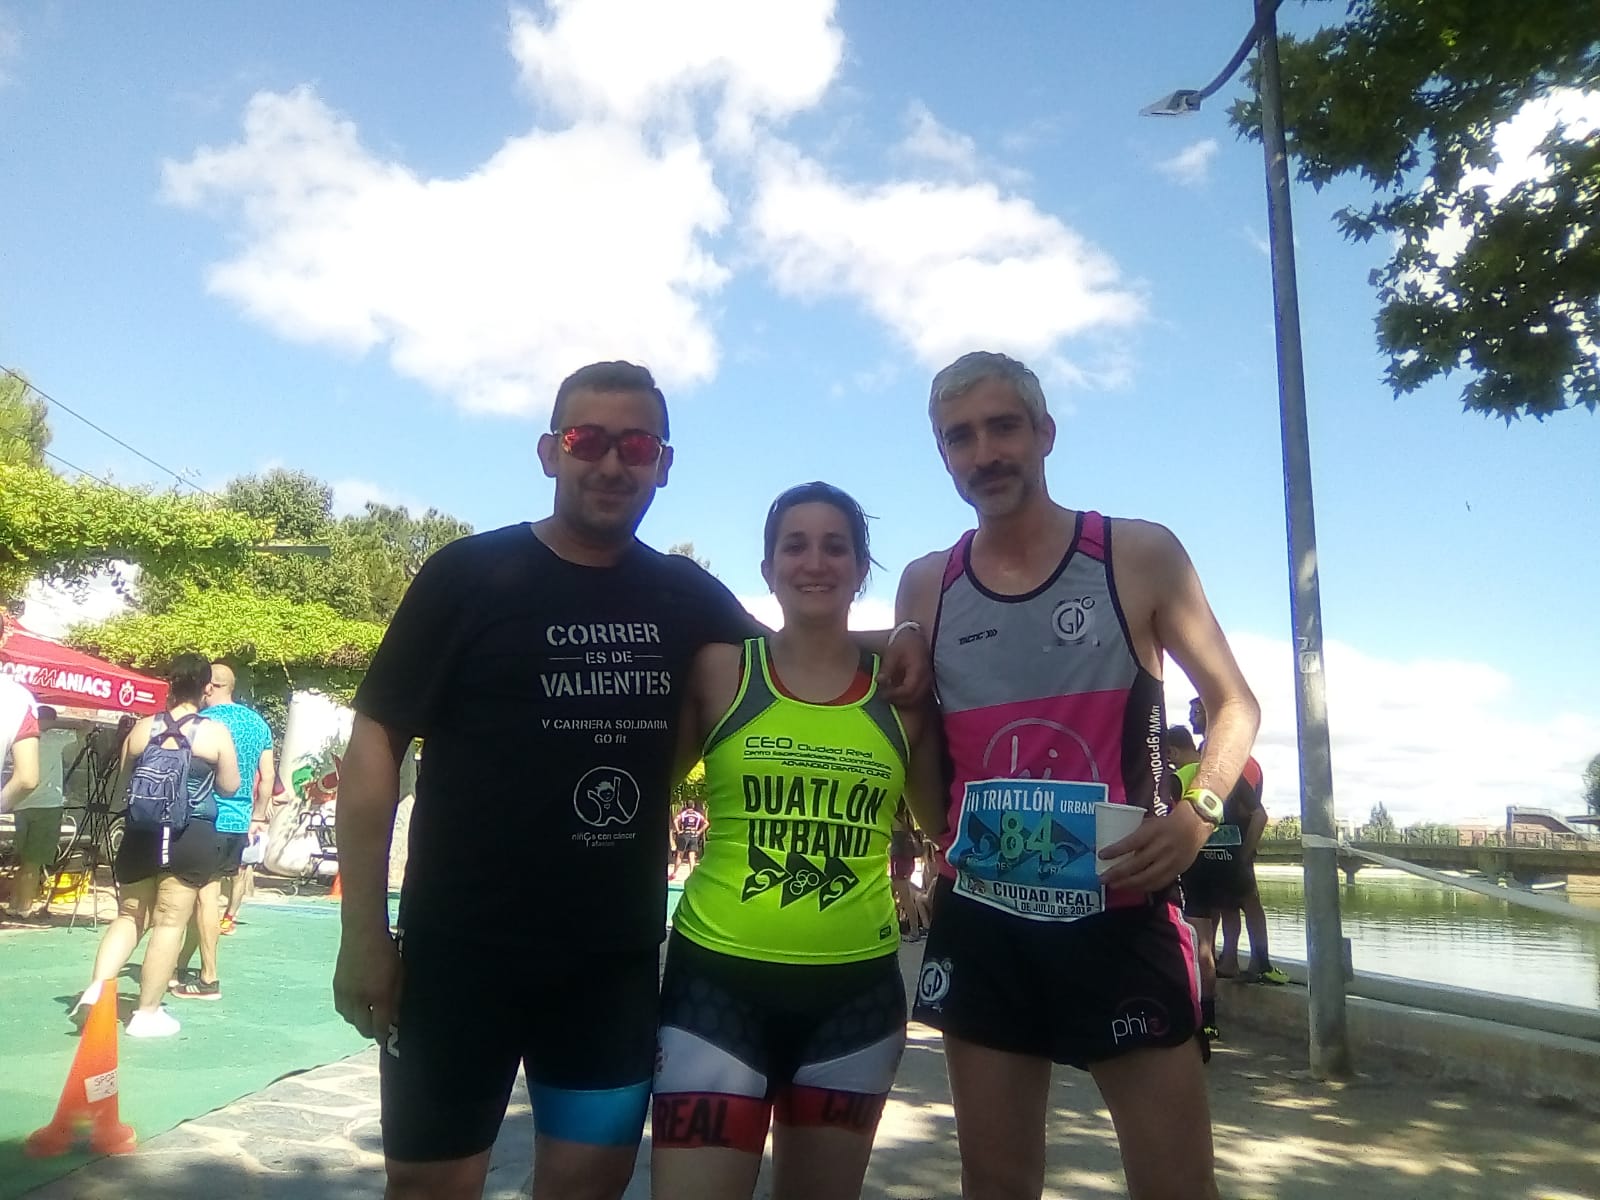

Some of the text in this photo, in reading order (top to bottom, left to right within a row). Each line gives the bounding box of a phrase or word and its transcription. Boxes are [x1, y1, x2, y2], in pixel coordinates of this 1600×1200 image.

[546, 623, 661, 646] CORRER
[586, 651, 633, 664] ES DE
[539, 671, 671, 697] VALIENTES
[542, 719, 668, 729] V CARRERA SOLIDARIA
[594, 733, 627, 744] GO fit
[746, 736, 872, 758] CEO Ciudad Real
[742, 774, 888, 825] DUATLÓN
[982, 787, 1055, 812] TRIATLÓN
[1060, 800, 1095, 814] URBAN
[748, 819, 871, 858] URBANO
[1001, 810, 1054, 861] 84
[993, 882, 1094, 906] CIUDAD REAL
[1020, 902, 1032, 912] DE
[1033, 904, 1056, 914] JULIO
[1057, 906, 1068, 915] DE
[1111, 1010, 1148, 1045] phi
